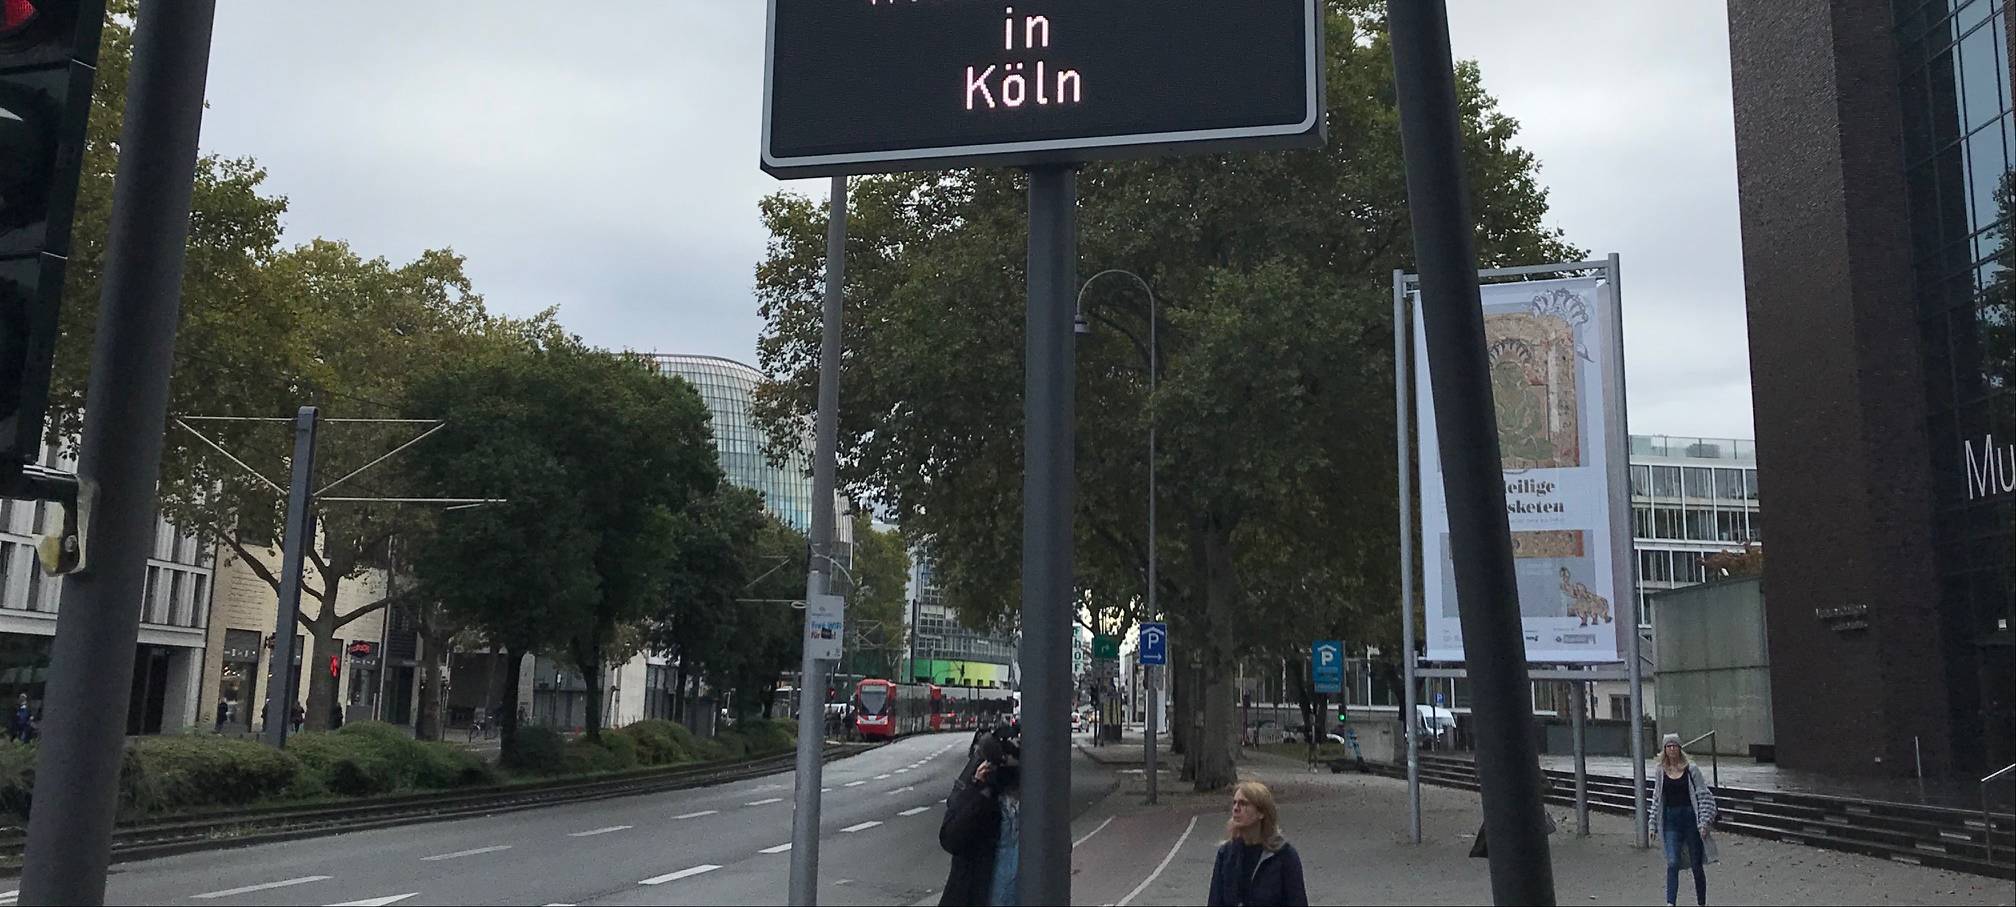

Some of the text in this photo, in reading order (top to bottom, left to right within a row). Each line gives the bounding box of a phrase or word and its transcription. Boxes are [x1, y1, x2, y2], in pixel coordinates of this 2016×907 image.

[1005, 7, 1049, 50] in
[966, 60, 1081, 110] Köln
[1505, 479, 1555, 496] eilige
[1507, 500, 1565, 514] sketen
[1148, 633, 1159, 649] P
[1321, 651, 1334, 666] P
